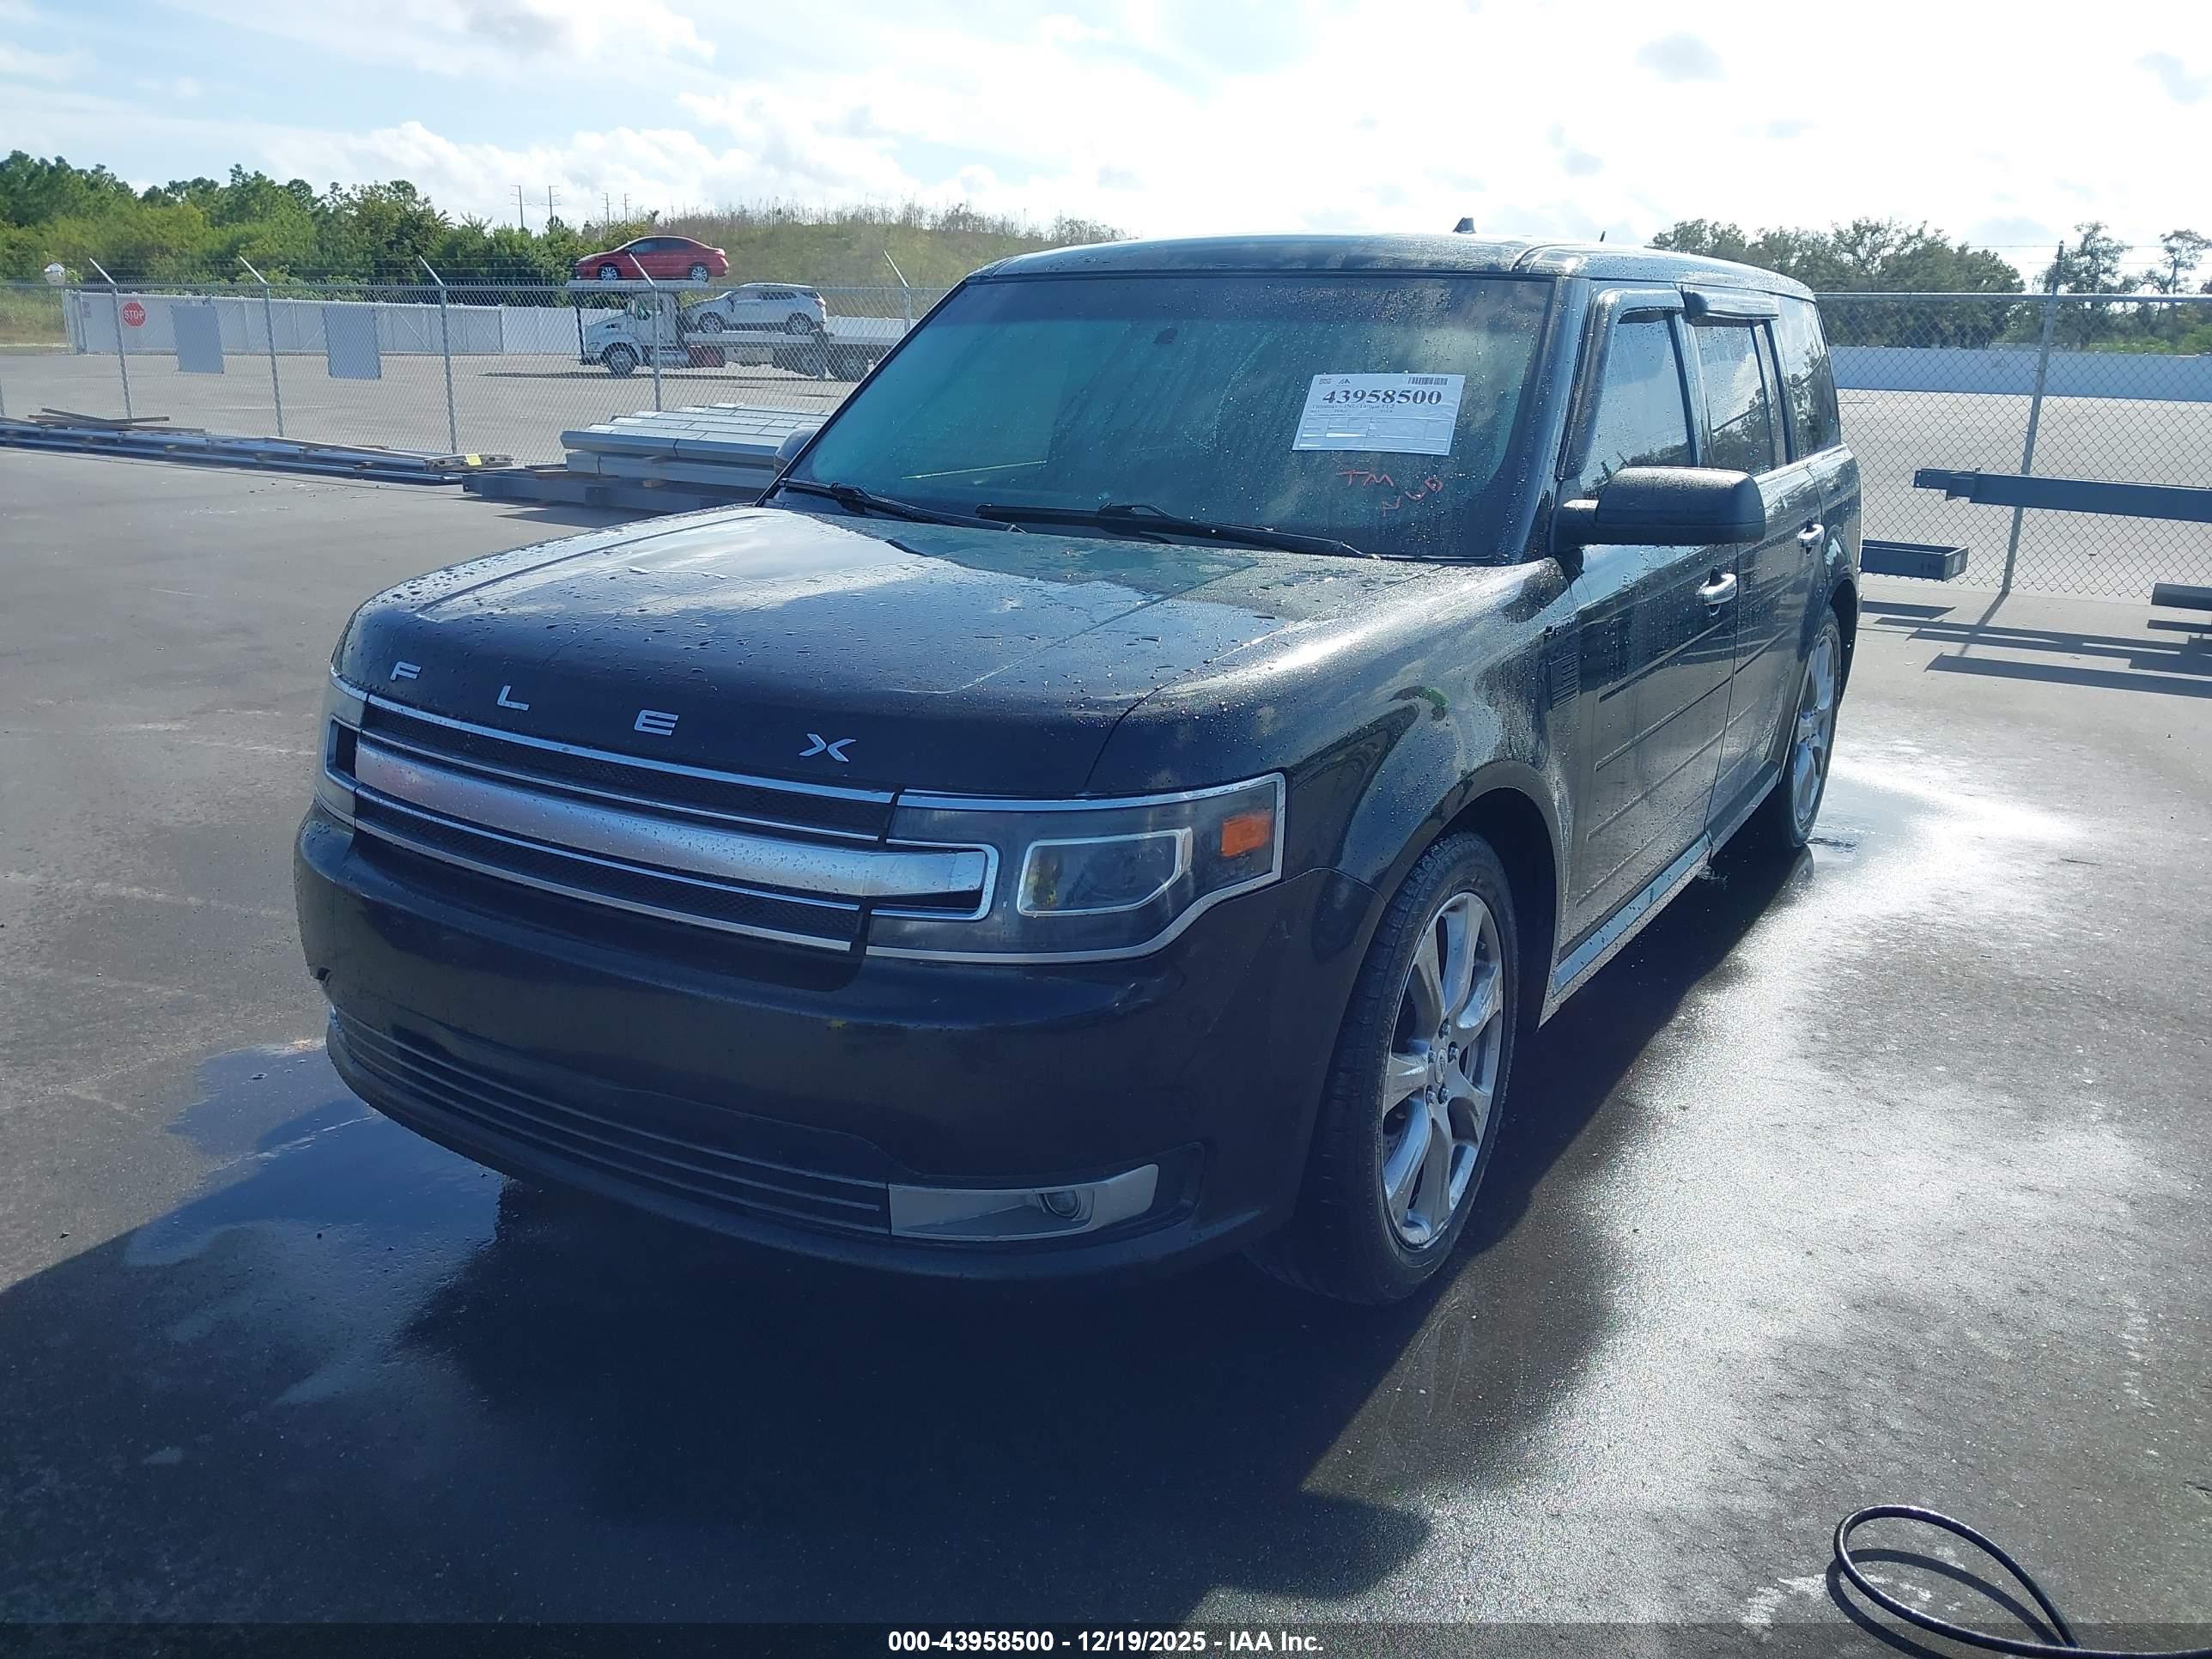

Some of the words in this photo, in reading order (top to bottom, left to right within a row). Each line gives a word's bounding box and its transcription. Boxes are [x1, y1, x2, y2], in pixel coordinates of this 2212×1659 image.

[124, 310, 145, 320] STOP
[1322, 389, 1442, 405] 43958500
[389, 660, 857, 763] FLEX
